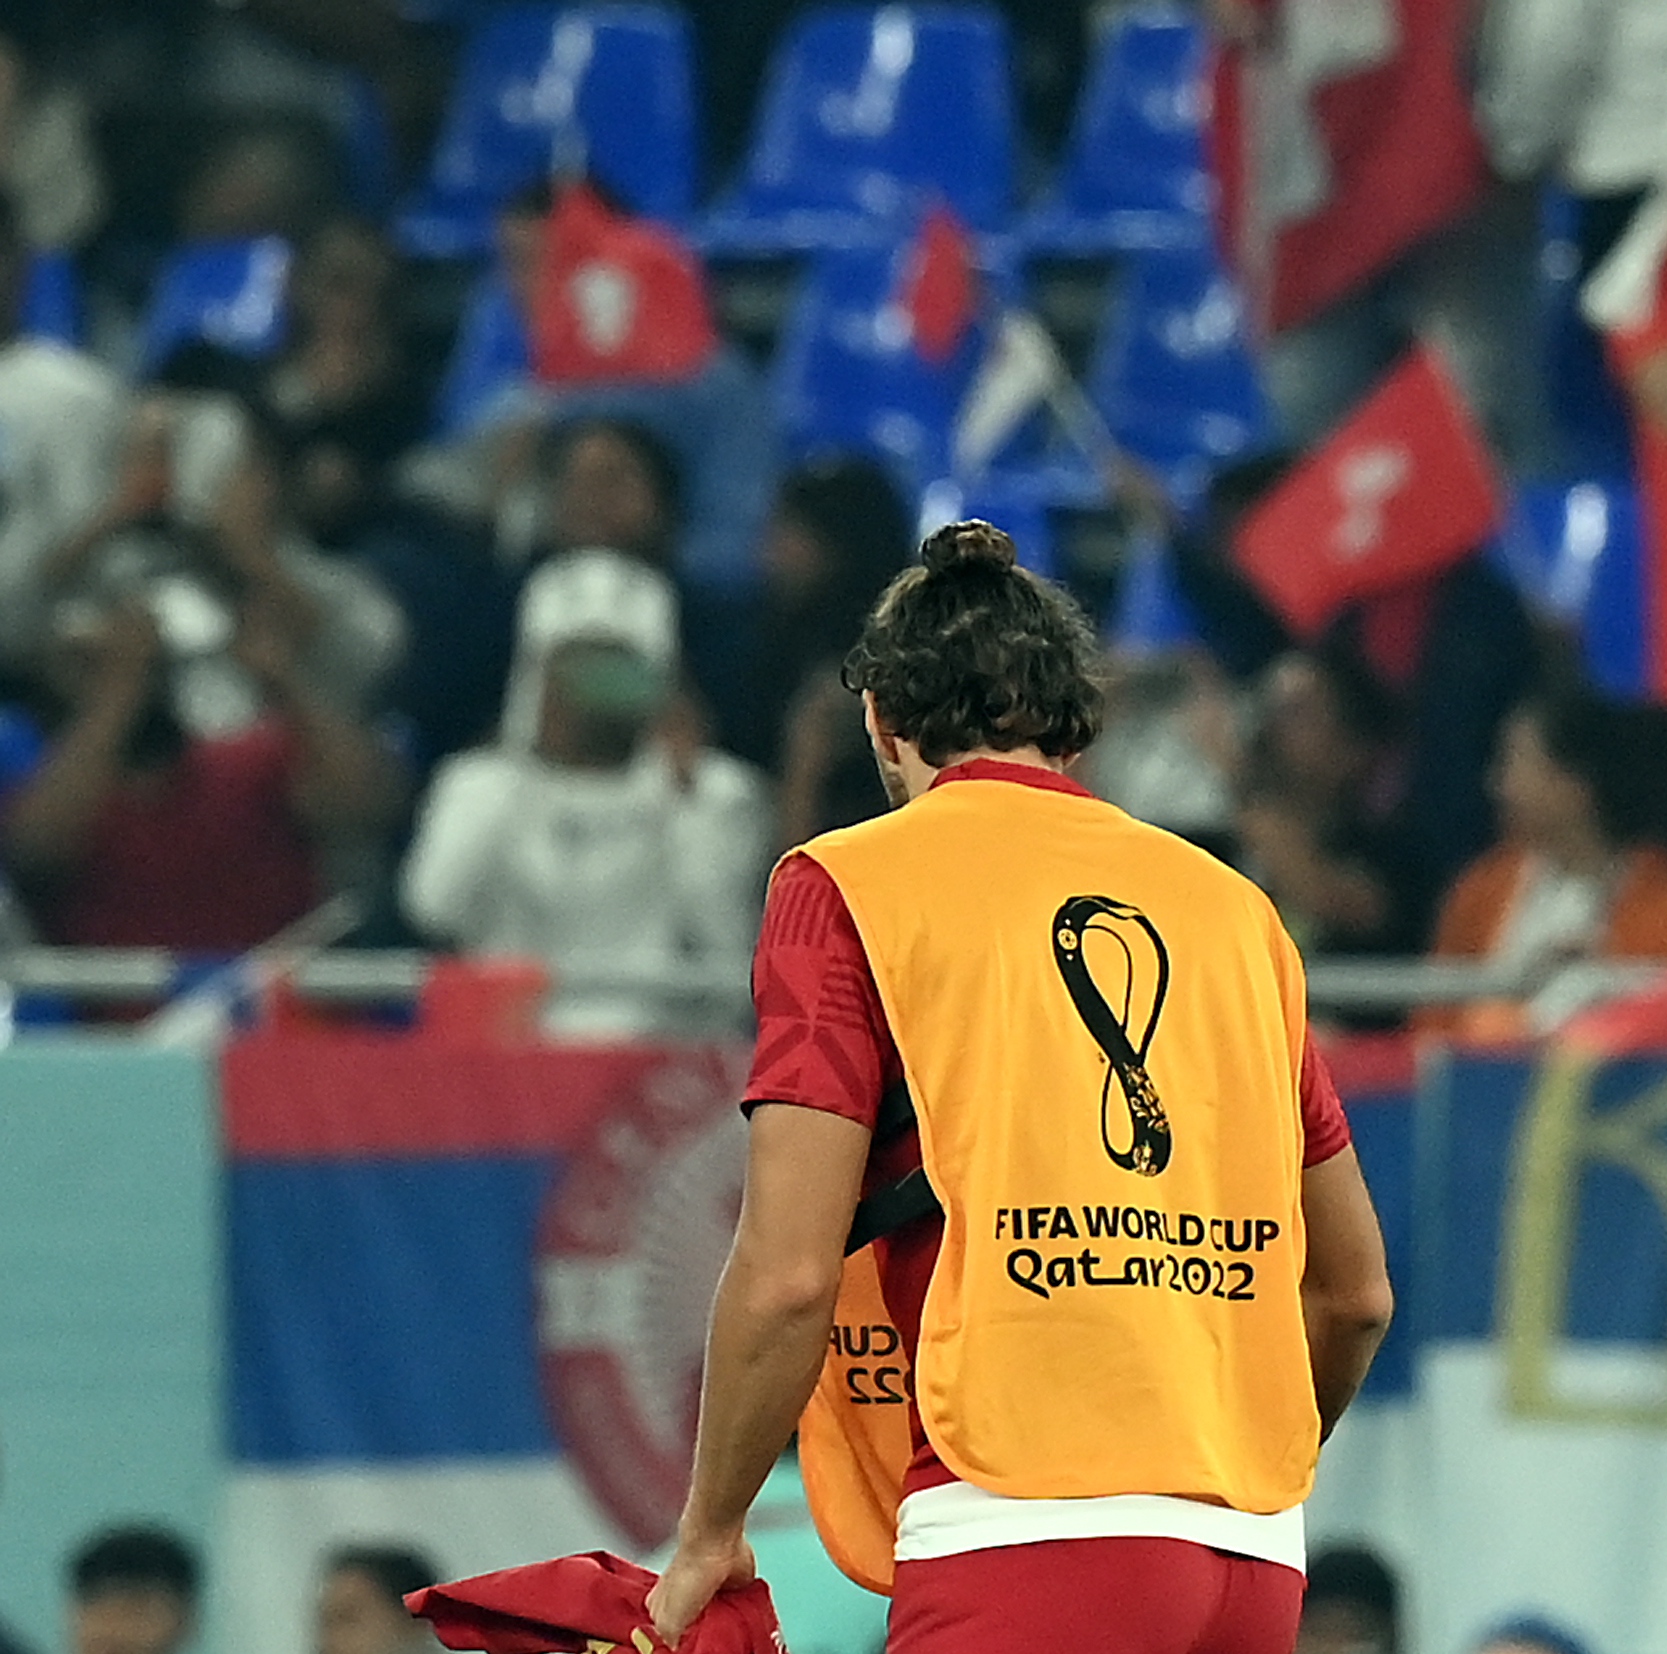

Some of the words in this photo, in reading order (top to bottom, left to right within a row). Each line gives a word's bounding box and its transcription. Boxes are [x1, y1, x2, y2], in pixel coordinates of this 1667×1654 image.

[995, 1206, 1079, 1240] FIFA
[1082, 1206, 1206, 1246] WORLD
[1210, 1219, 1280, 1252] CUP
